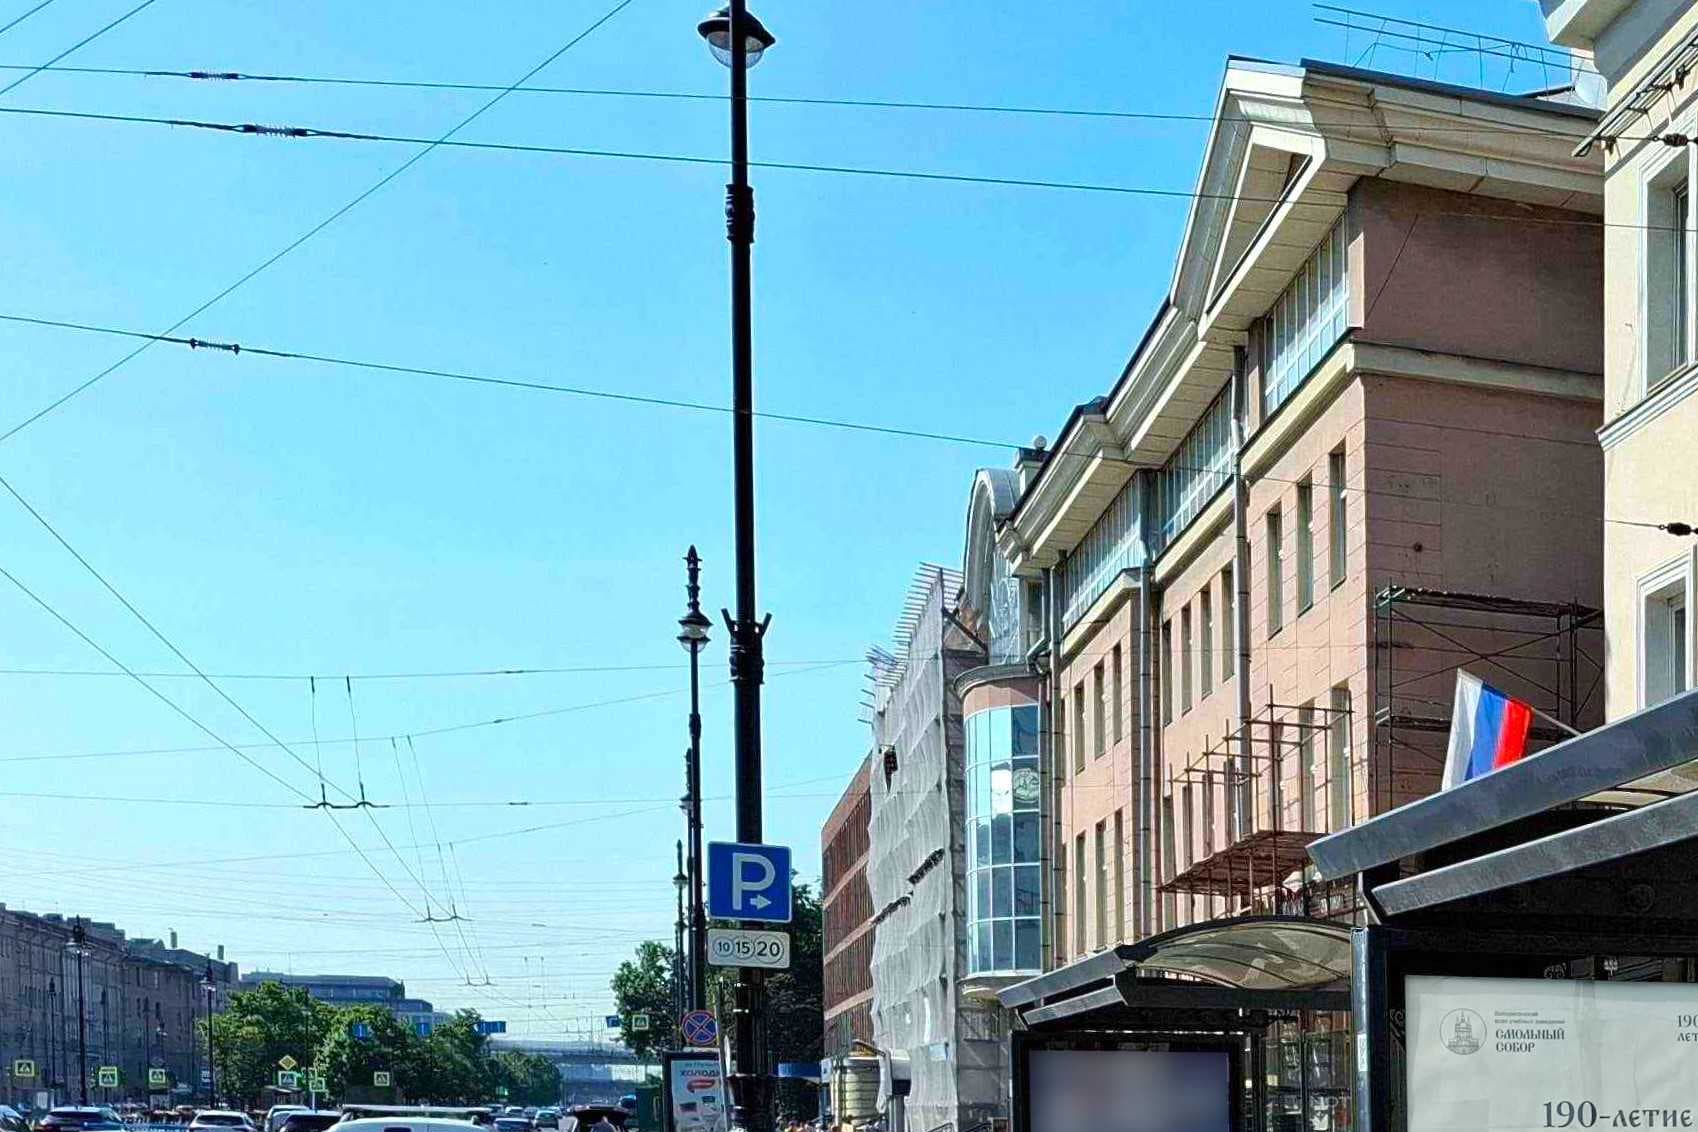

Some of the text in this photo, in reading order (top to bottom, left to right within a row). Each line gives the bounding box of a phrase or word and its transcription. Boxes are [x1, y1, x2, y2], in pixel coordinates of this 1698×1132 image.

[732, 852, 776, 911] P
[718, 941, 780, 957] 10 15 20
[1495, 1027, 1566, 1041] СМОЛЬНЫЙ
[1495, 1042, 1536, 1053] СОБОР
[1543, 1100, 1694, 1128] 190-летие
